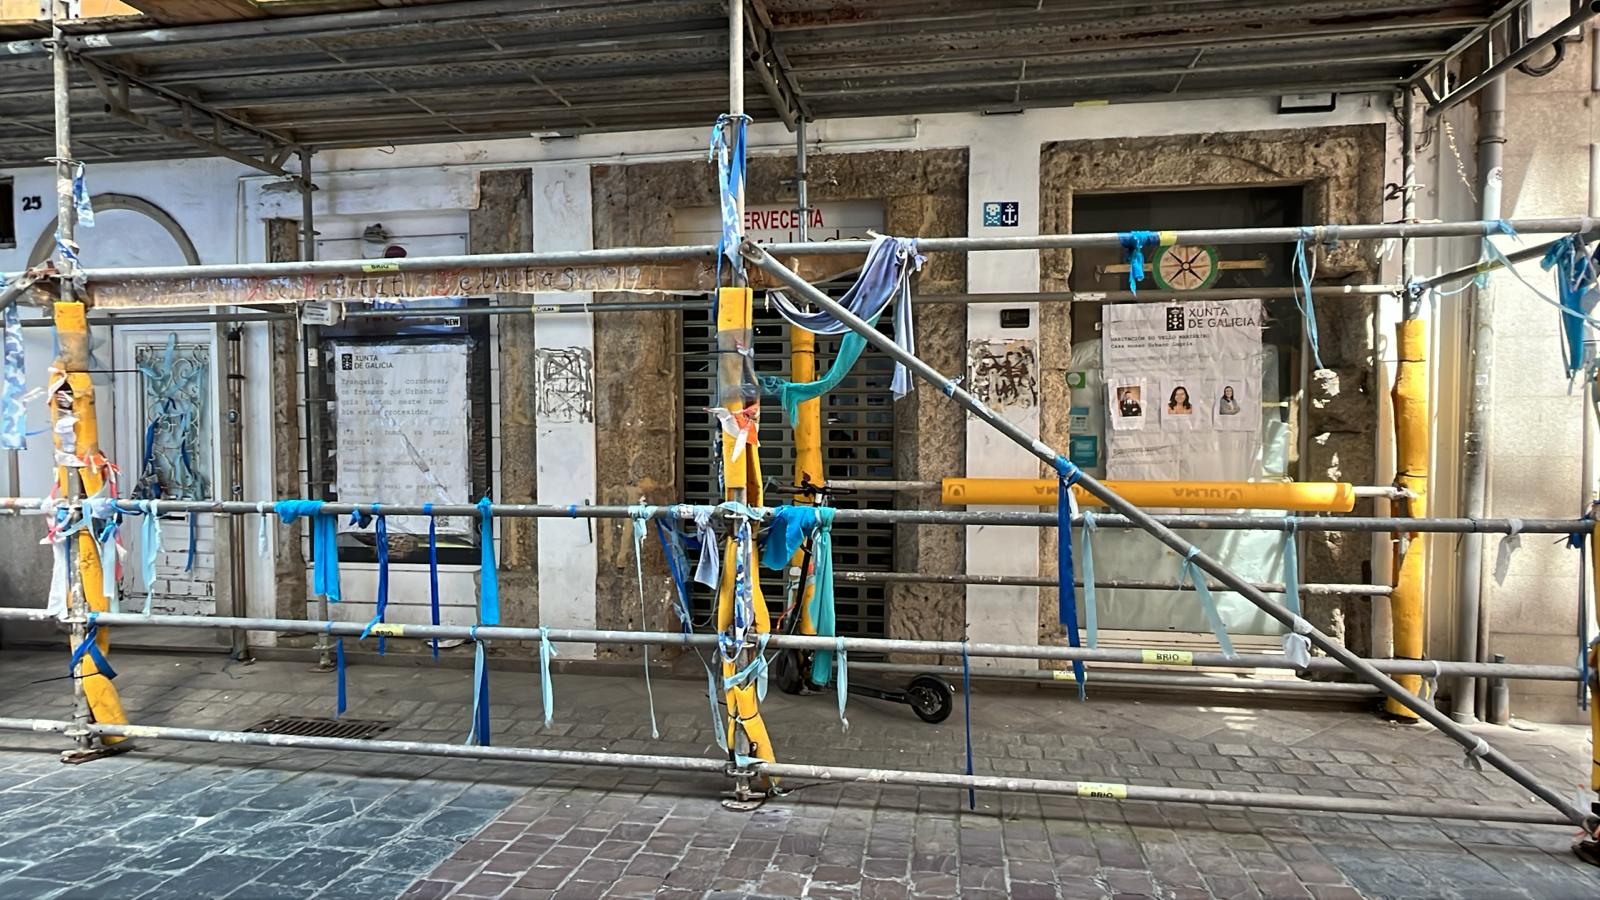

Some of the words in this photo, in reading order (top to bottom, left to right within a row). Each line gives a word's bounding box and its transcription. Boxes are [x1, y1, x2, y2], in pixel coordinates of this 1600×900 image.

[22, 196, 42, 211] 25
[744, 205, 824, 230] ERVECEÍA
[1189, 307, 1229, 317] XUNTA
[444, 318, 459, 326] NEW
[1188, 318, 1204, 328] DE
[1207, 317, 1255, 328] GALICIA
[365, 361, 393, 369] GALICIA
[1172, 487, 1222, 499] ULMA
[1156, 653, 1179, 661] BRIO
[1090, 791, 1114, 799] BRIO
